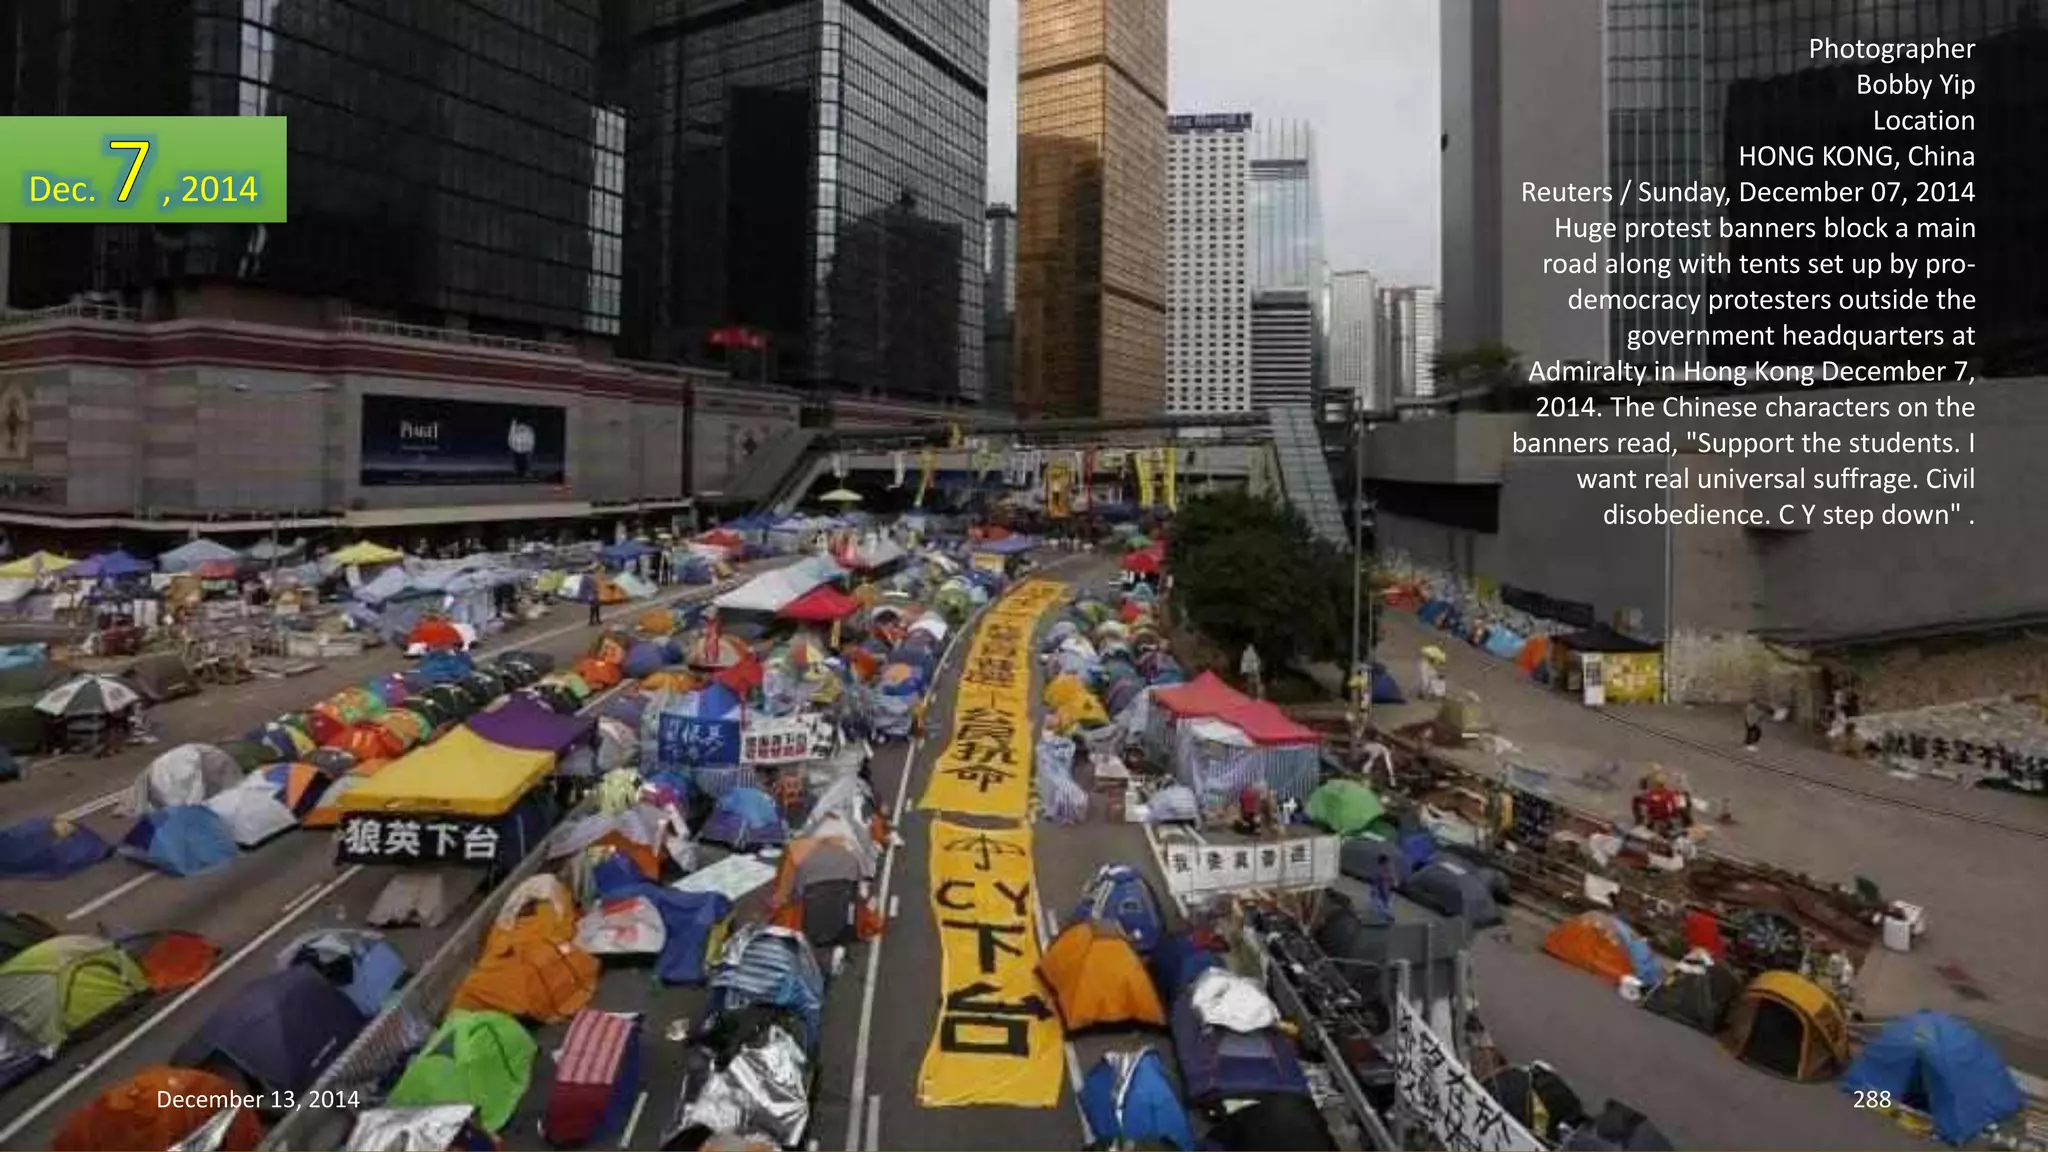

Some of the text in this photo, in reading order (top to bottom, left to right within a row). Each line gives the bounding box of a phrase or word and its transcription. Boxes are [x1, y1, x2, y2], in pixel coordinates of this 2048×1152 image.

[345, 818, 499, 860] 狼英下台
[940, 919, 1053, 1057] 下台
